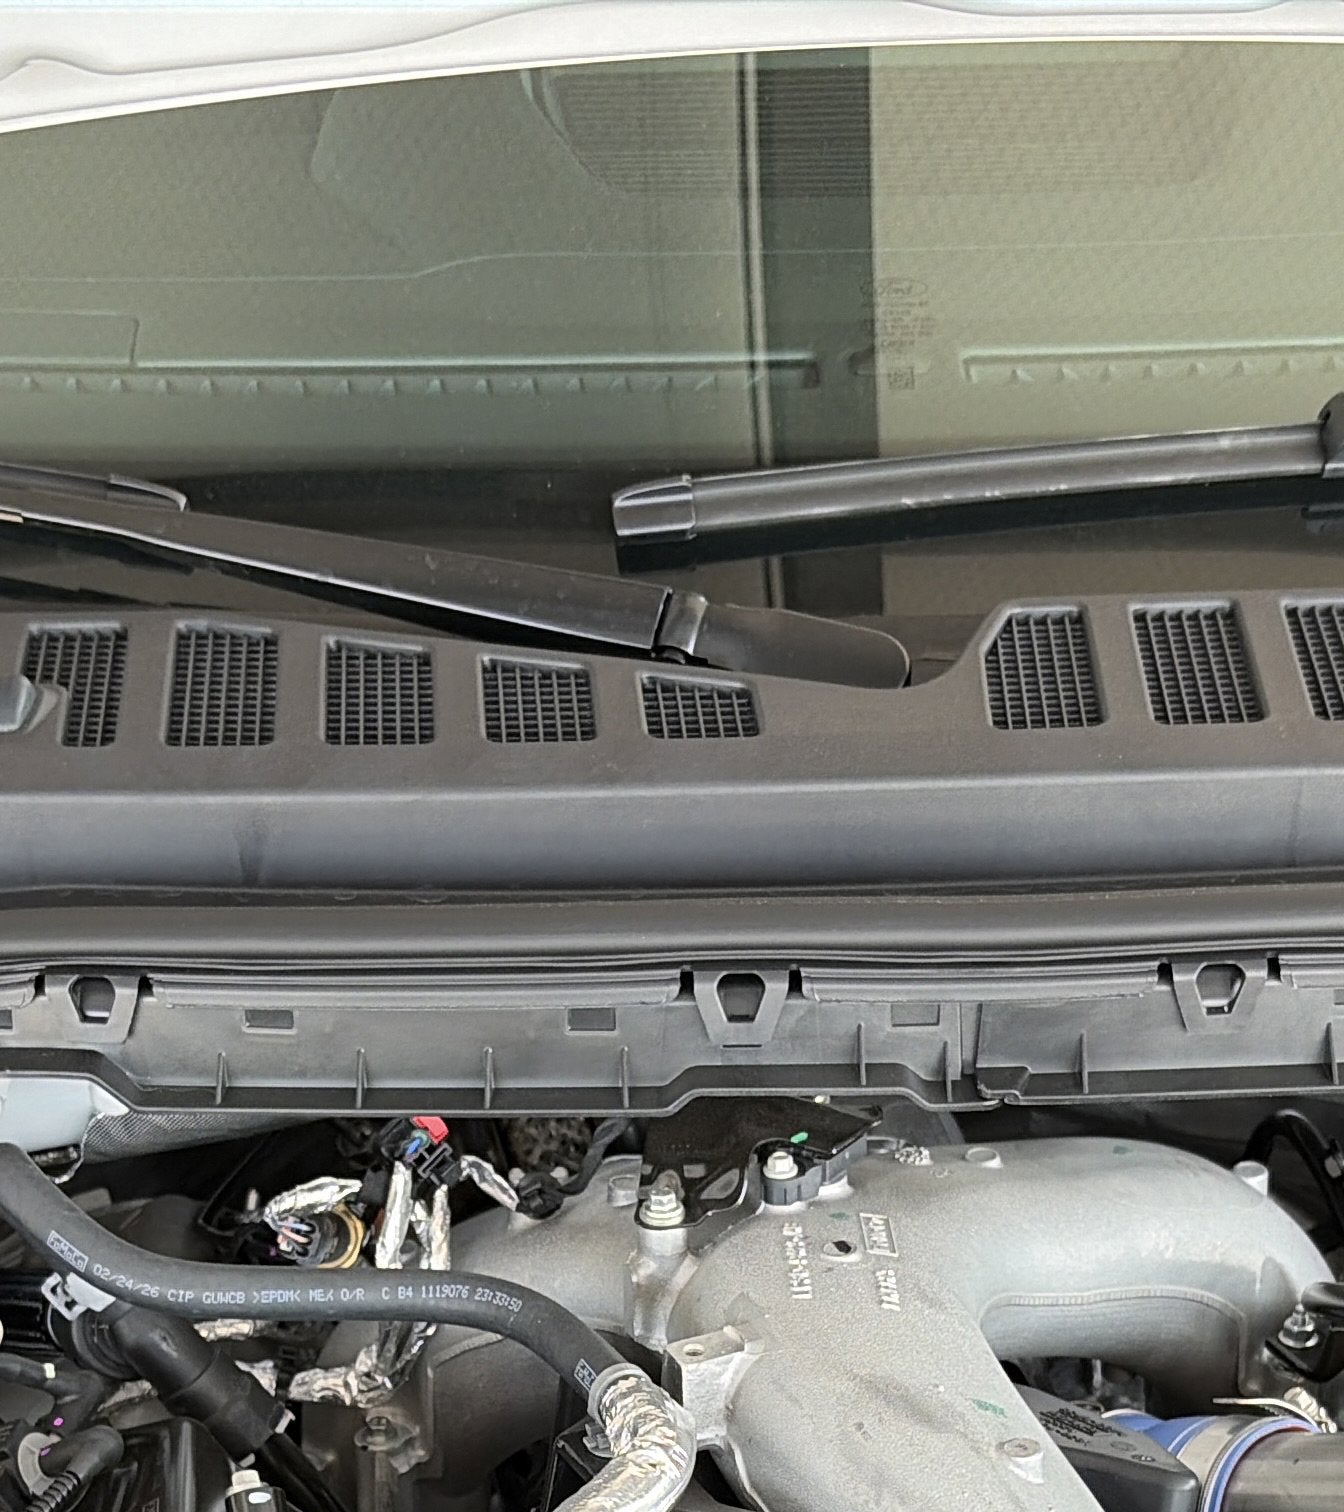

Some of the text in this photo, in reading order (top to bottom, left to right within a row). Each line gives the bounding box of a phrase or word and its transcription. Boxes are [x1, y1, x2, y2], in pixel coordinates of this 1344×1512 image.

[49, 1233, 87, 1270] FoMoCo
[93, 1263, 160, 1298] 02/24/26
[167, 1291, 194, 1303] CIP
[421, 1285, 469, 1299] 1119076
